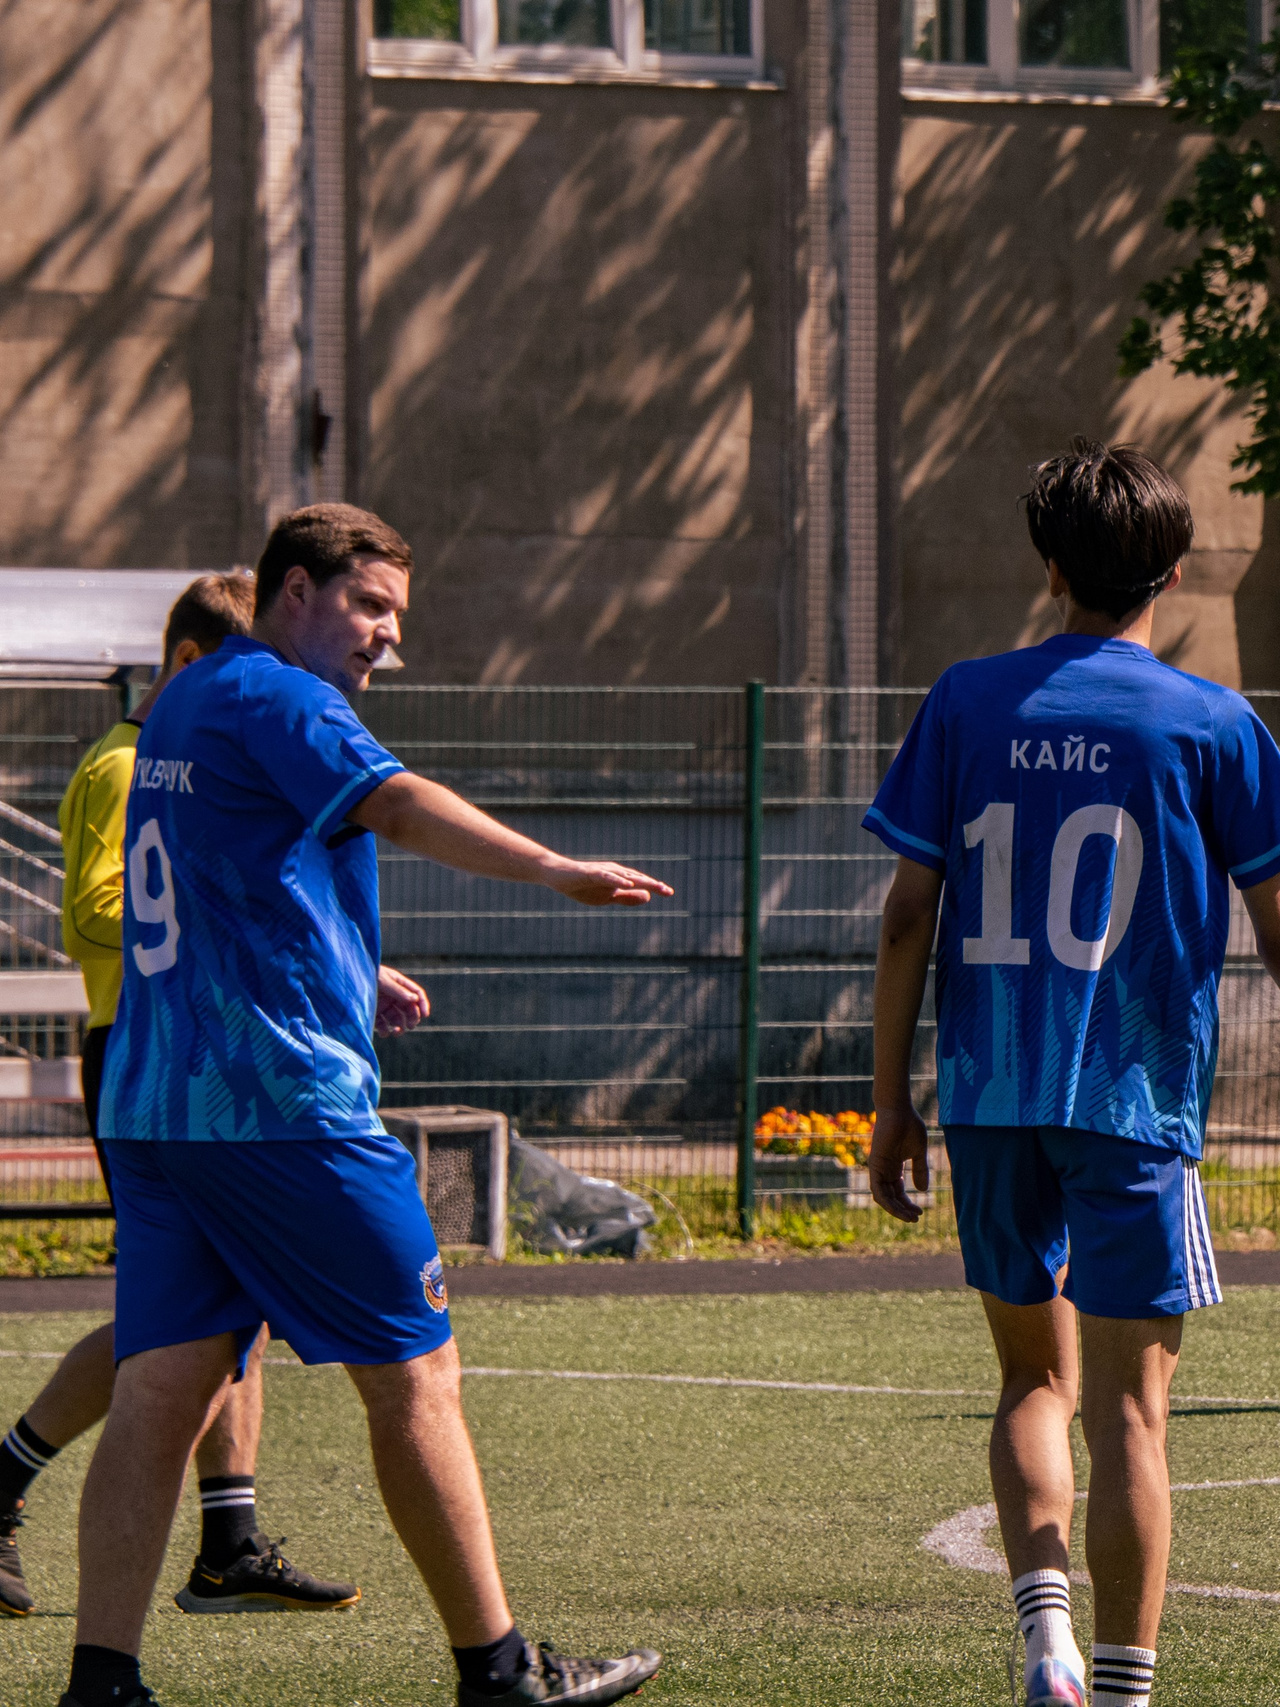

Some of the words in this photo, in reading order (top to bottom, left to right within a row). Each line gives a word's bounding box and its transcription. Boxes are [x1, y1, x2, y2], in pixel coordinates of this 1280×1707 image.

[1009, 734, 1112, 774] КАЙС
[129, 817, 181, 978] 9
[962, 802, 1145, 972] 10
